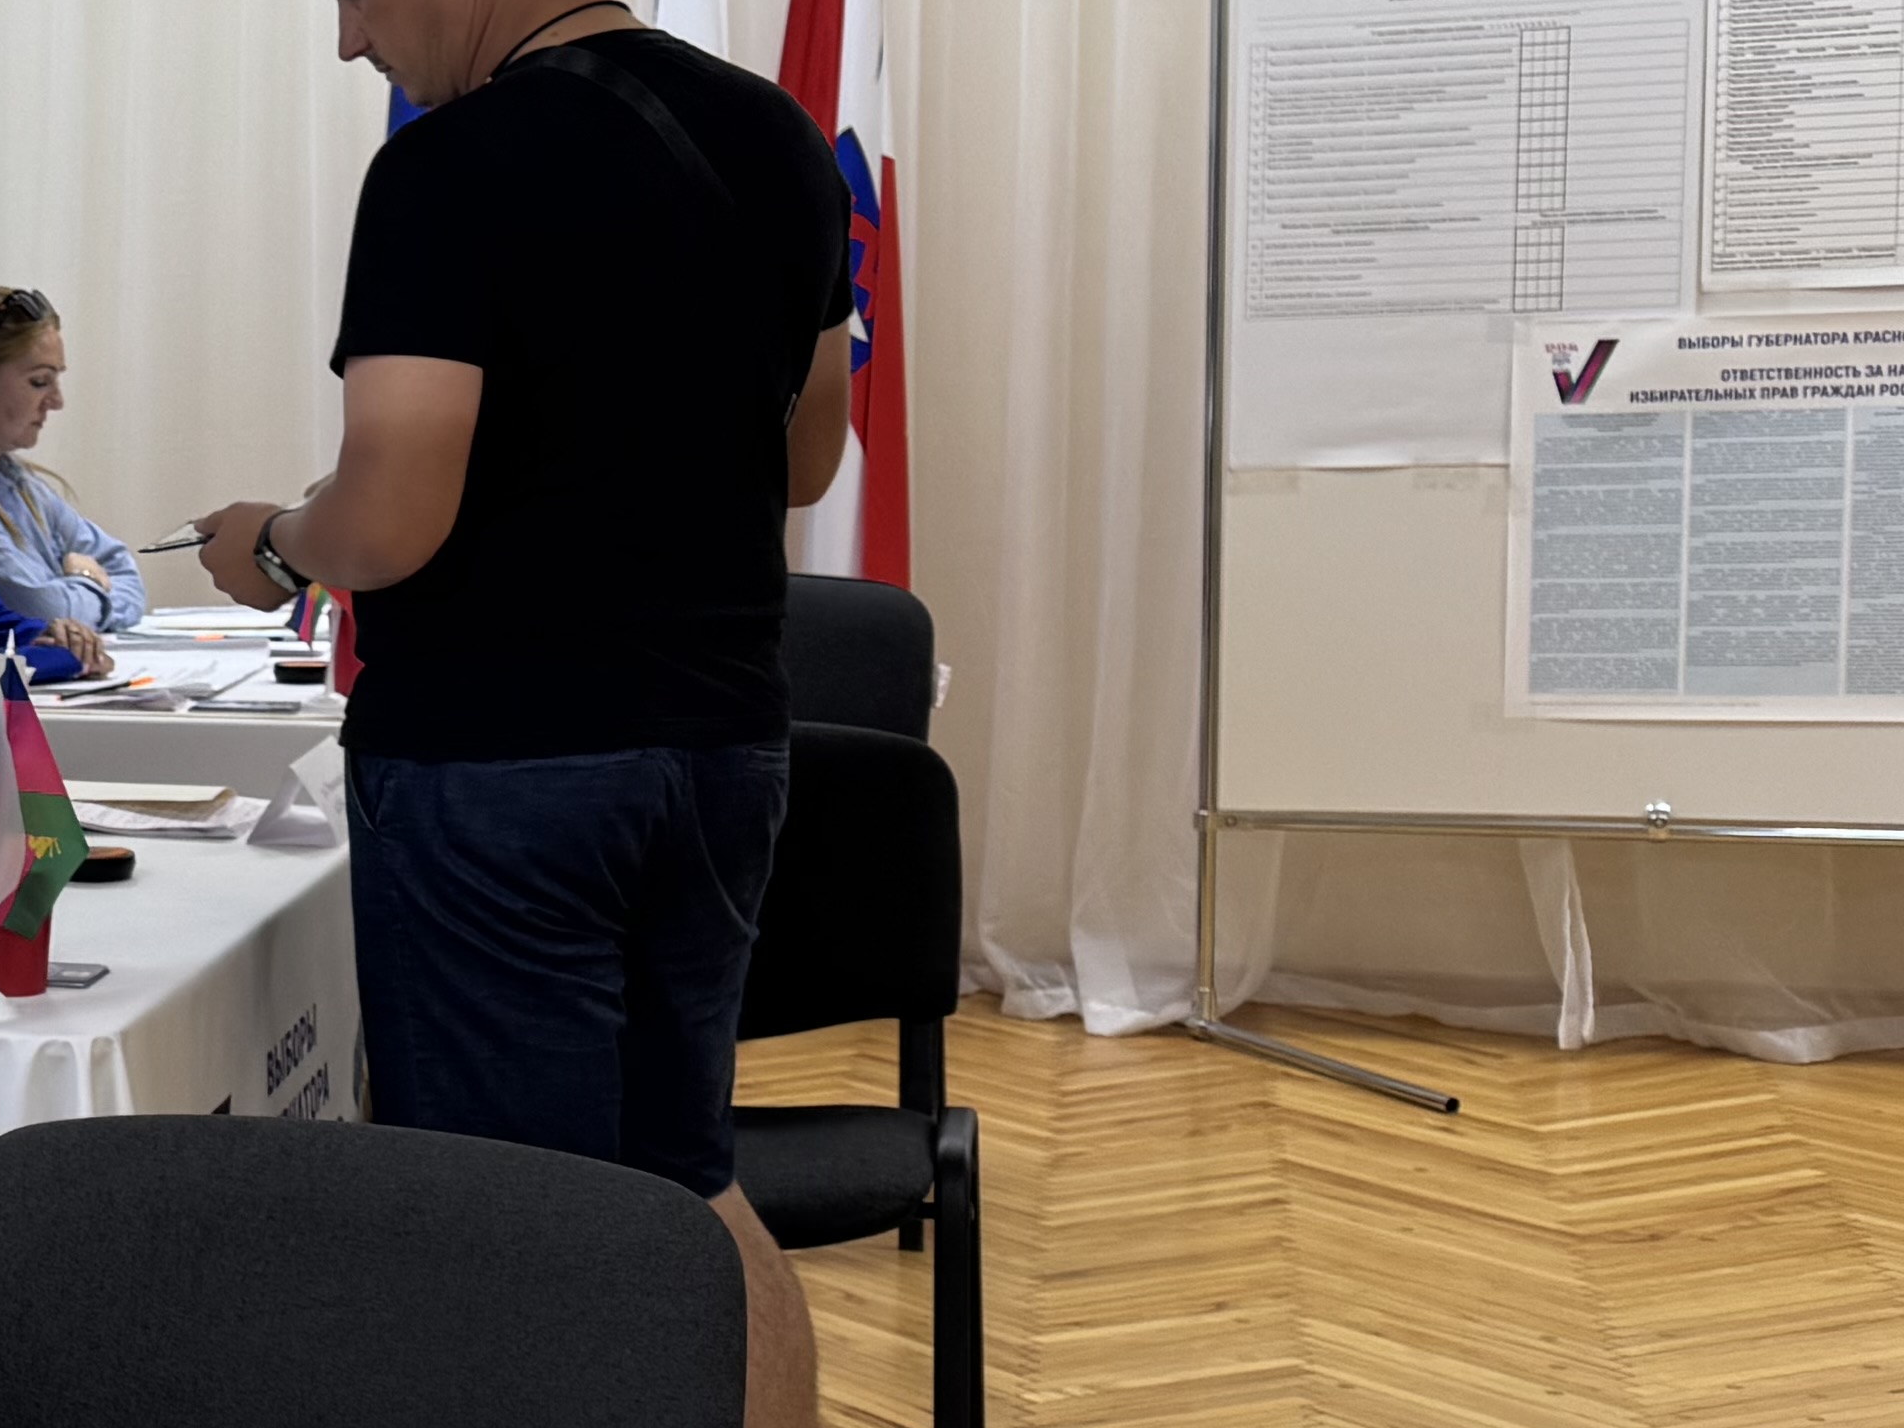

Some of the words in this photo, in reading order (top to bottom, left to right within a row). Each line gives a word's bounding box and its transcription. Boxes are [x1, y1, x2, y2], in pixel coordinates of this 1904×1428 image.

[1678, 335, 1743, 350] ВЫБОРЫ
[1748, 332, 1848, 348] ГУБЕРНАТОРА
[1853, 330, 1904, 345] КРАСН
[1721, 365, 1861, 382] ОТВЕТСТВЕННОСТЬ
[1865, 364, 1884, 378] ЗА
[1630, 388, 1756, 404] ИЗБИРАТЕЛЬНЫХ
[1760, 387, 1799, 400] ПРАВ
[1803, 384, 1875, 399] ГРАЖДАН
[267, 1003, 317, 1097] ВЫБОРЫ
